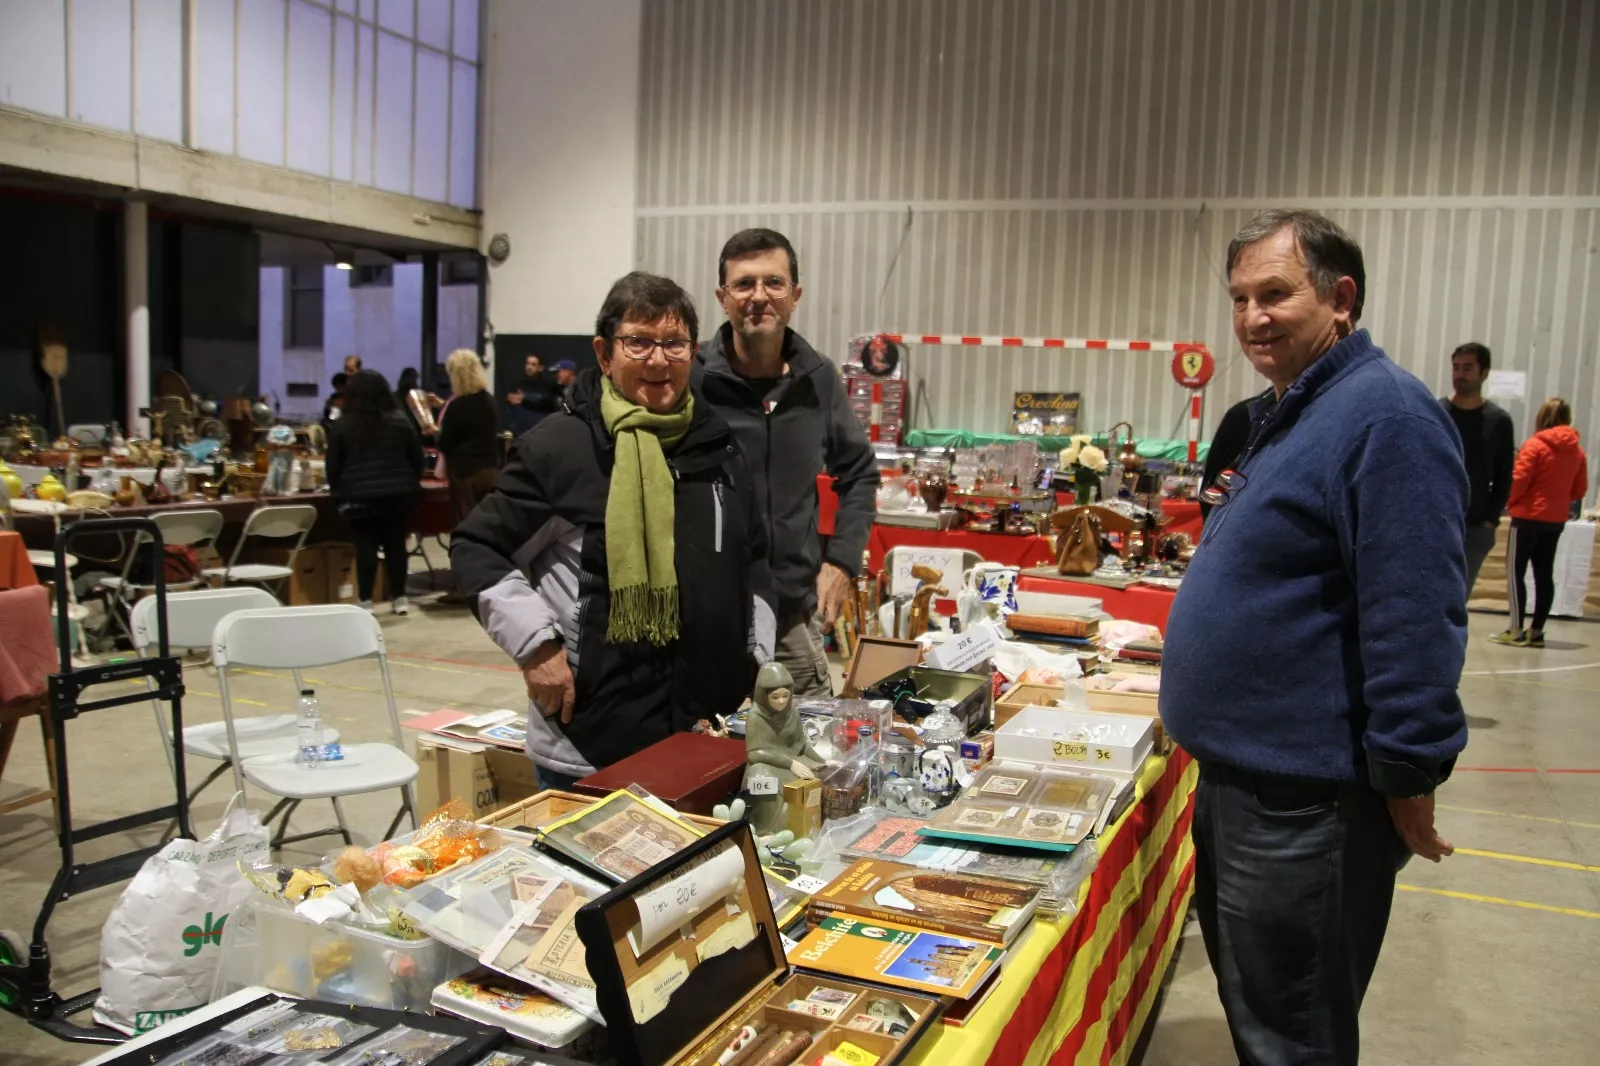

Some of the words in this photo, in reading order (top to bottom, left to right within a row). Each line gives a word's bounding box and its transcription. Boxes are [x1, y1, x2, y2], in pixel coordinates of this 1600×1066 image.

[958, 640, 967, 650] 20
[967, 637, 973, 645] €
[1053, 741, 1062, 757] 2
[1096, 749, 1110, 760] 3€
[799, 917, 858, 961] Belchite
